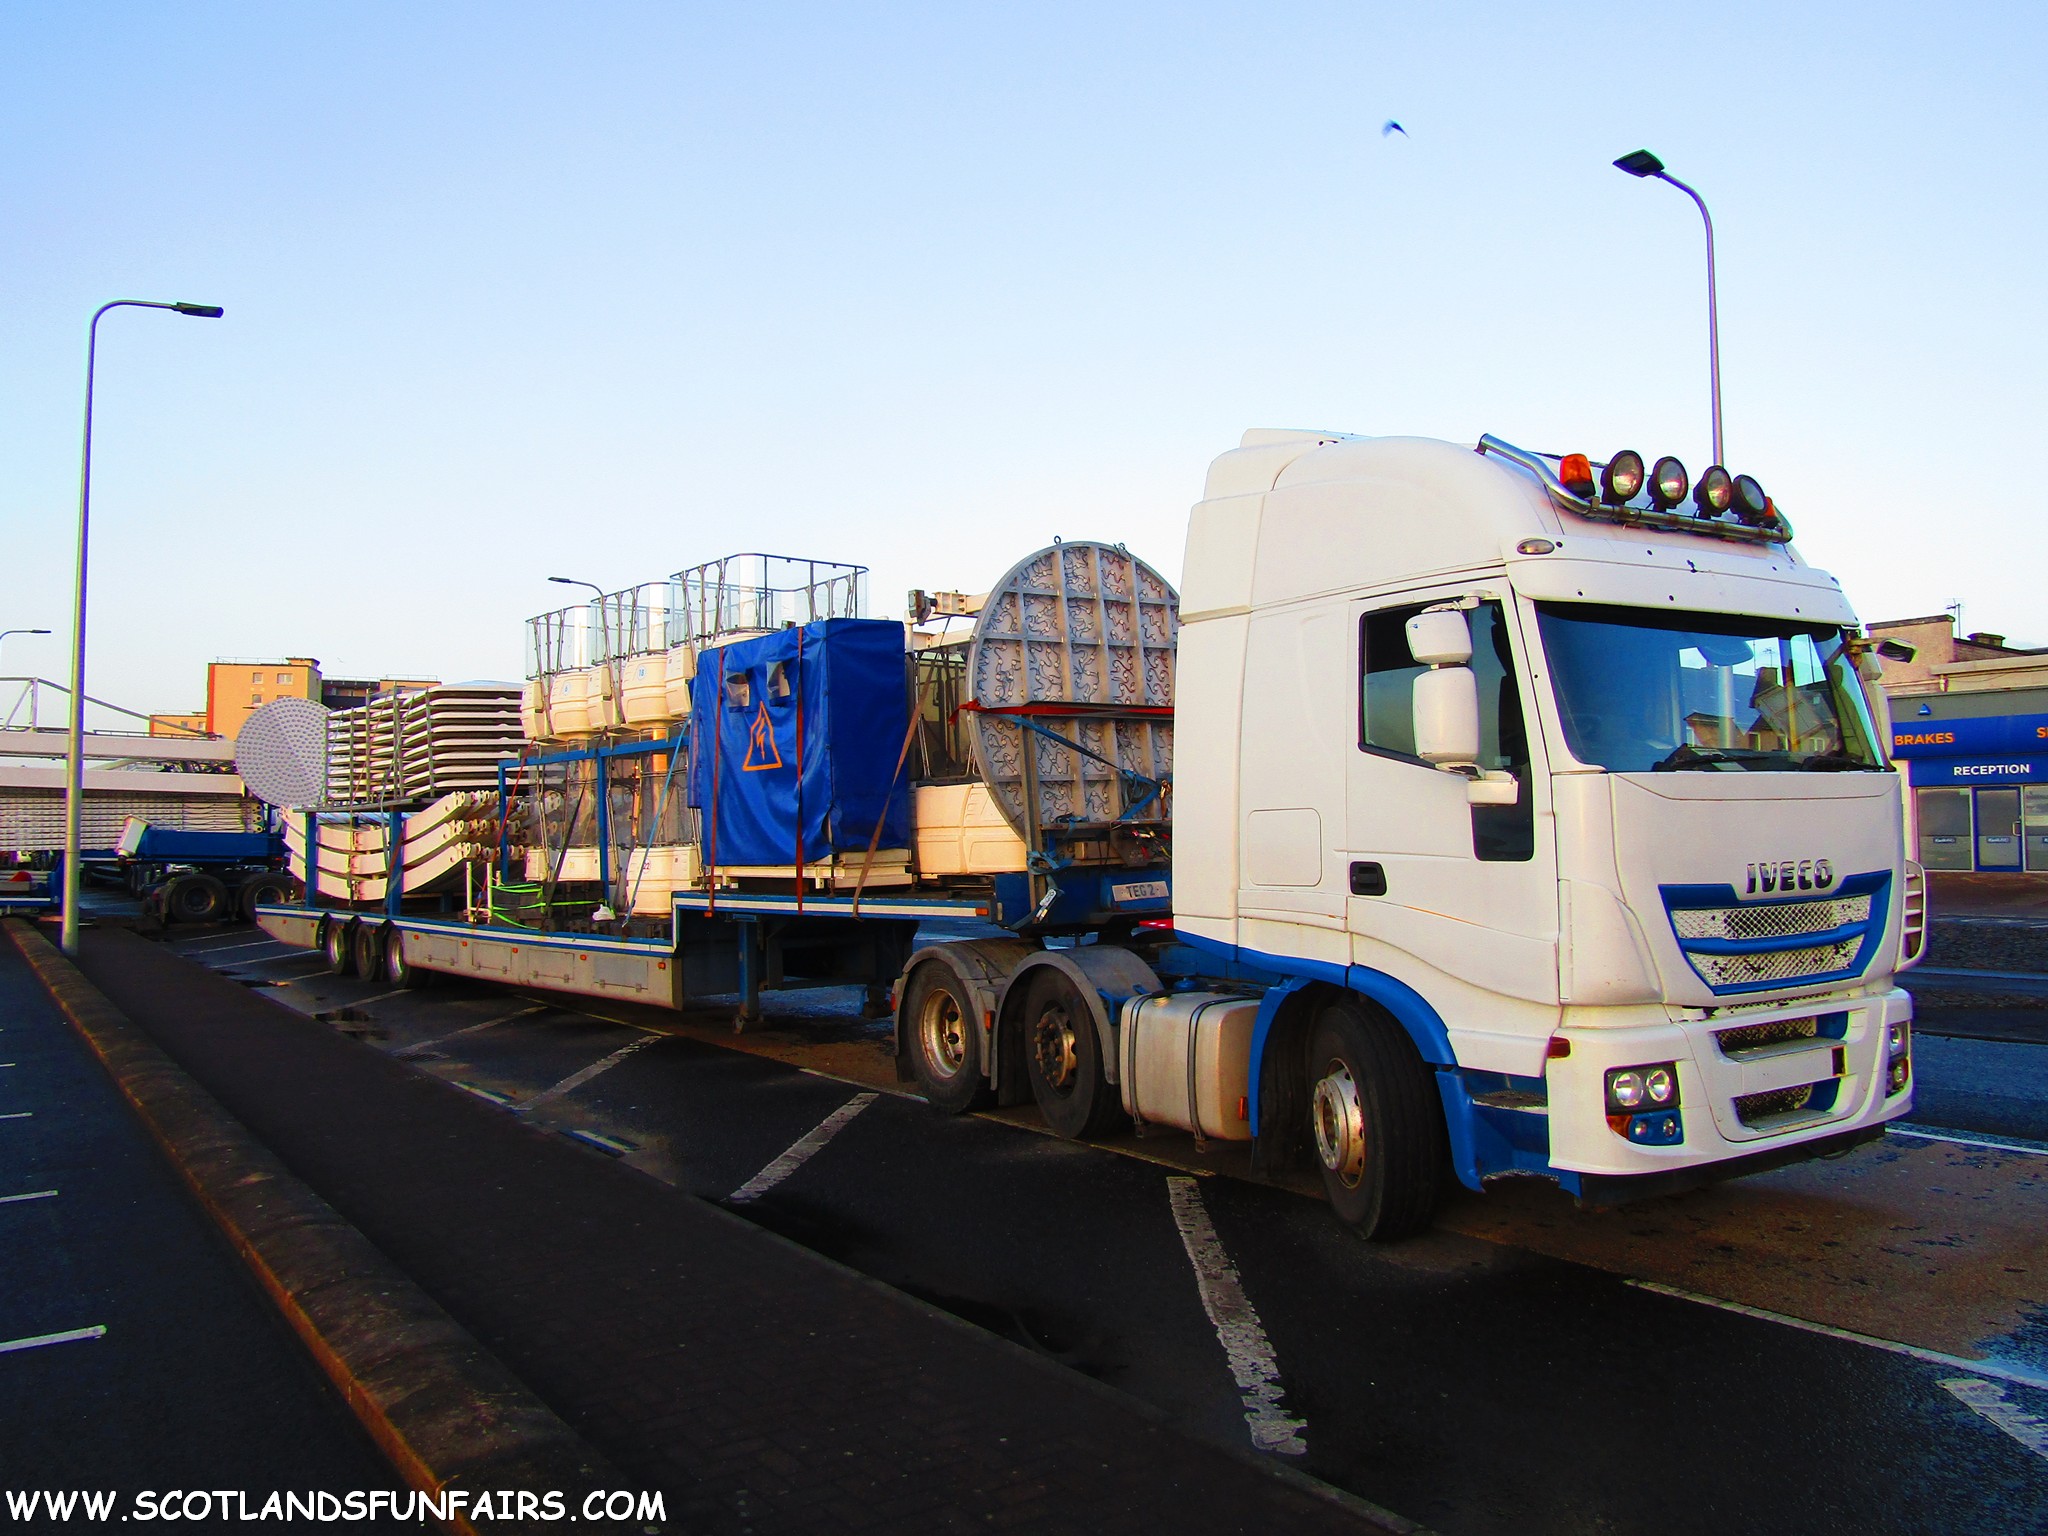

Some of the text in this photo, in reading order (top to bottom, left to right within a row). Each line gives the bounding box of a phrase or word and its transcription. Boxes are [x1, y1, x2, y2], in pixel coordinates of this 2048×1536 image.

[1894, 732, 1955, 746] BRAKES
[1953, 763, 2031, 776] RECEPTION
[1746, 858, 1834, 894] IVECO
[1126, 883, 1156, 898] TEG 2
